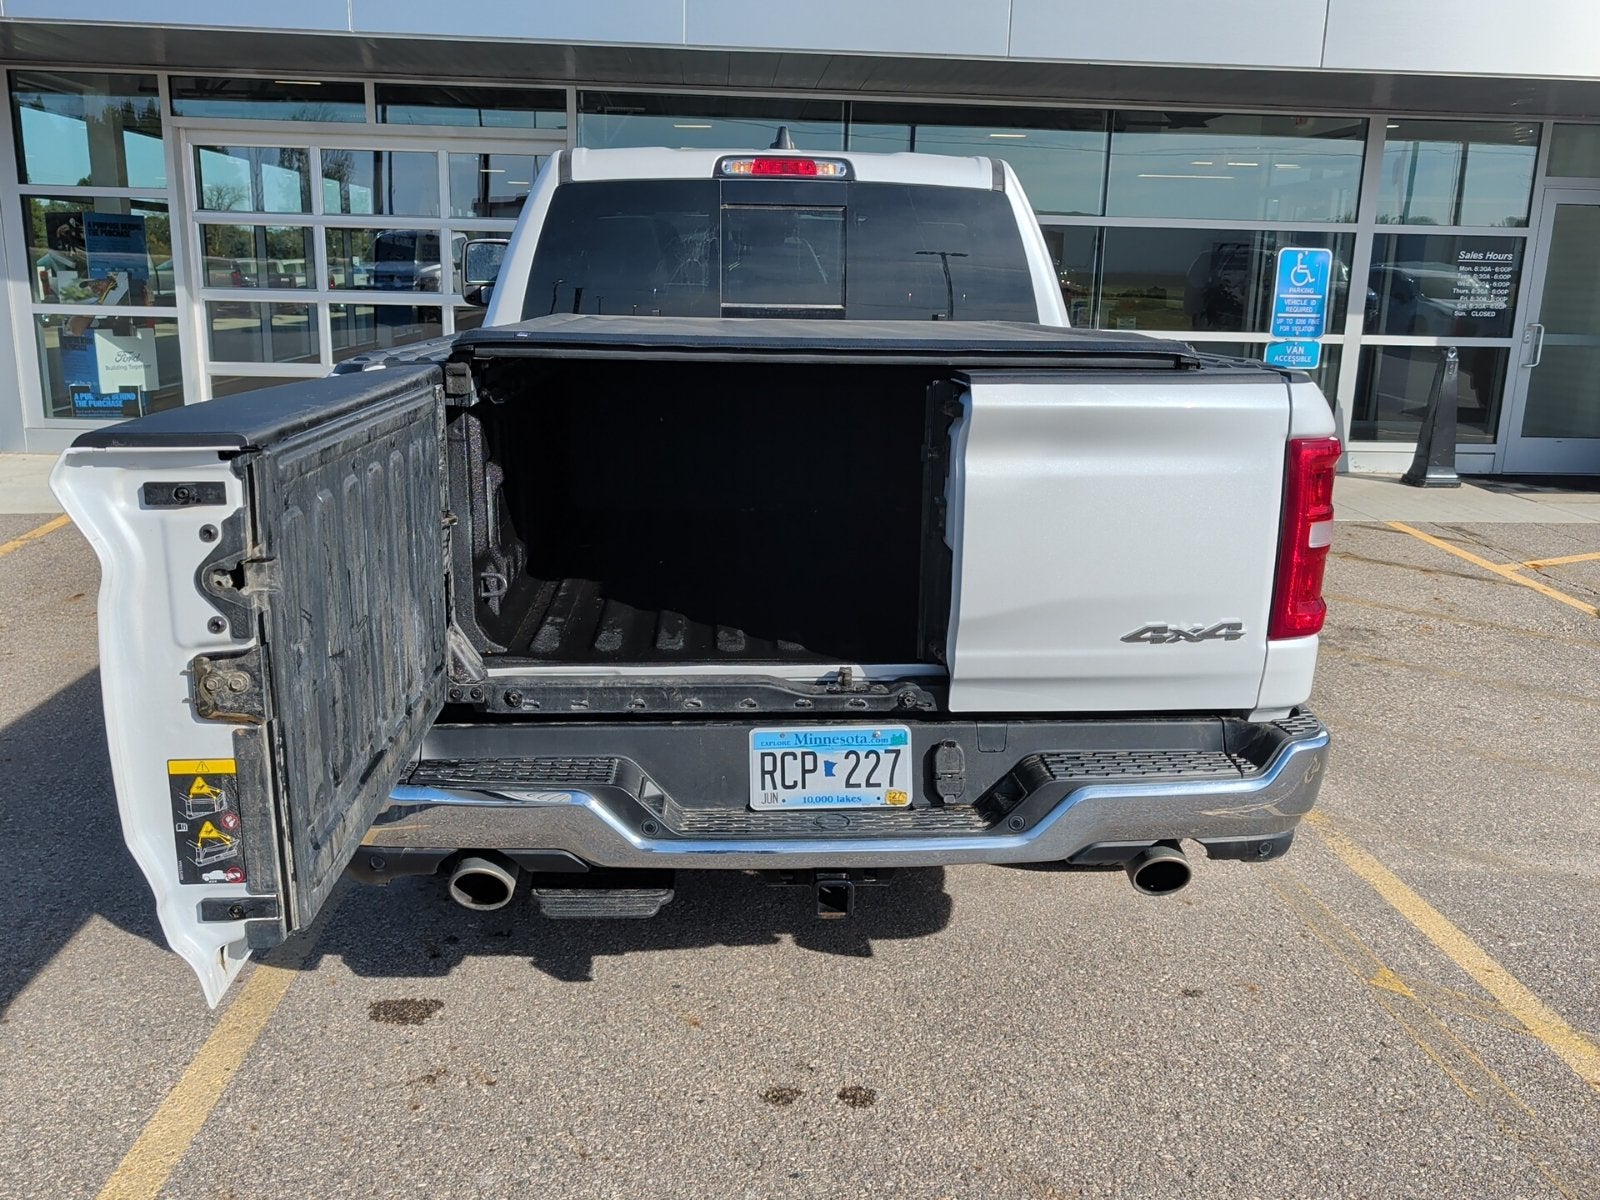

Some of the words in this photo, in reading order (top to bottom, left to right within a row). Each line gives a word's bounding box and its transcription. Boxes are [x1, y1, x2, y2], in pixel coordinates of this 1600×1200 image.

[1458, 250, 1484, 260] Sales
[1485, 251, 1513, 260] Hours
[1284, 298, 1308, 306] VEHICLE
[1286, 345, 1305, 355] VAN
[115, 350, 142, 363] Ford
[1273, 354, 1312, 363] ACCESSIBLE
[760, 750, 818, 791] RCP
[844, 749, 901, 789] 227
[761, 792, 779, 805] JUN
[803, 795, 834, 804] 10,000
[836, 794, 862, 803] lakes
